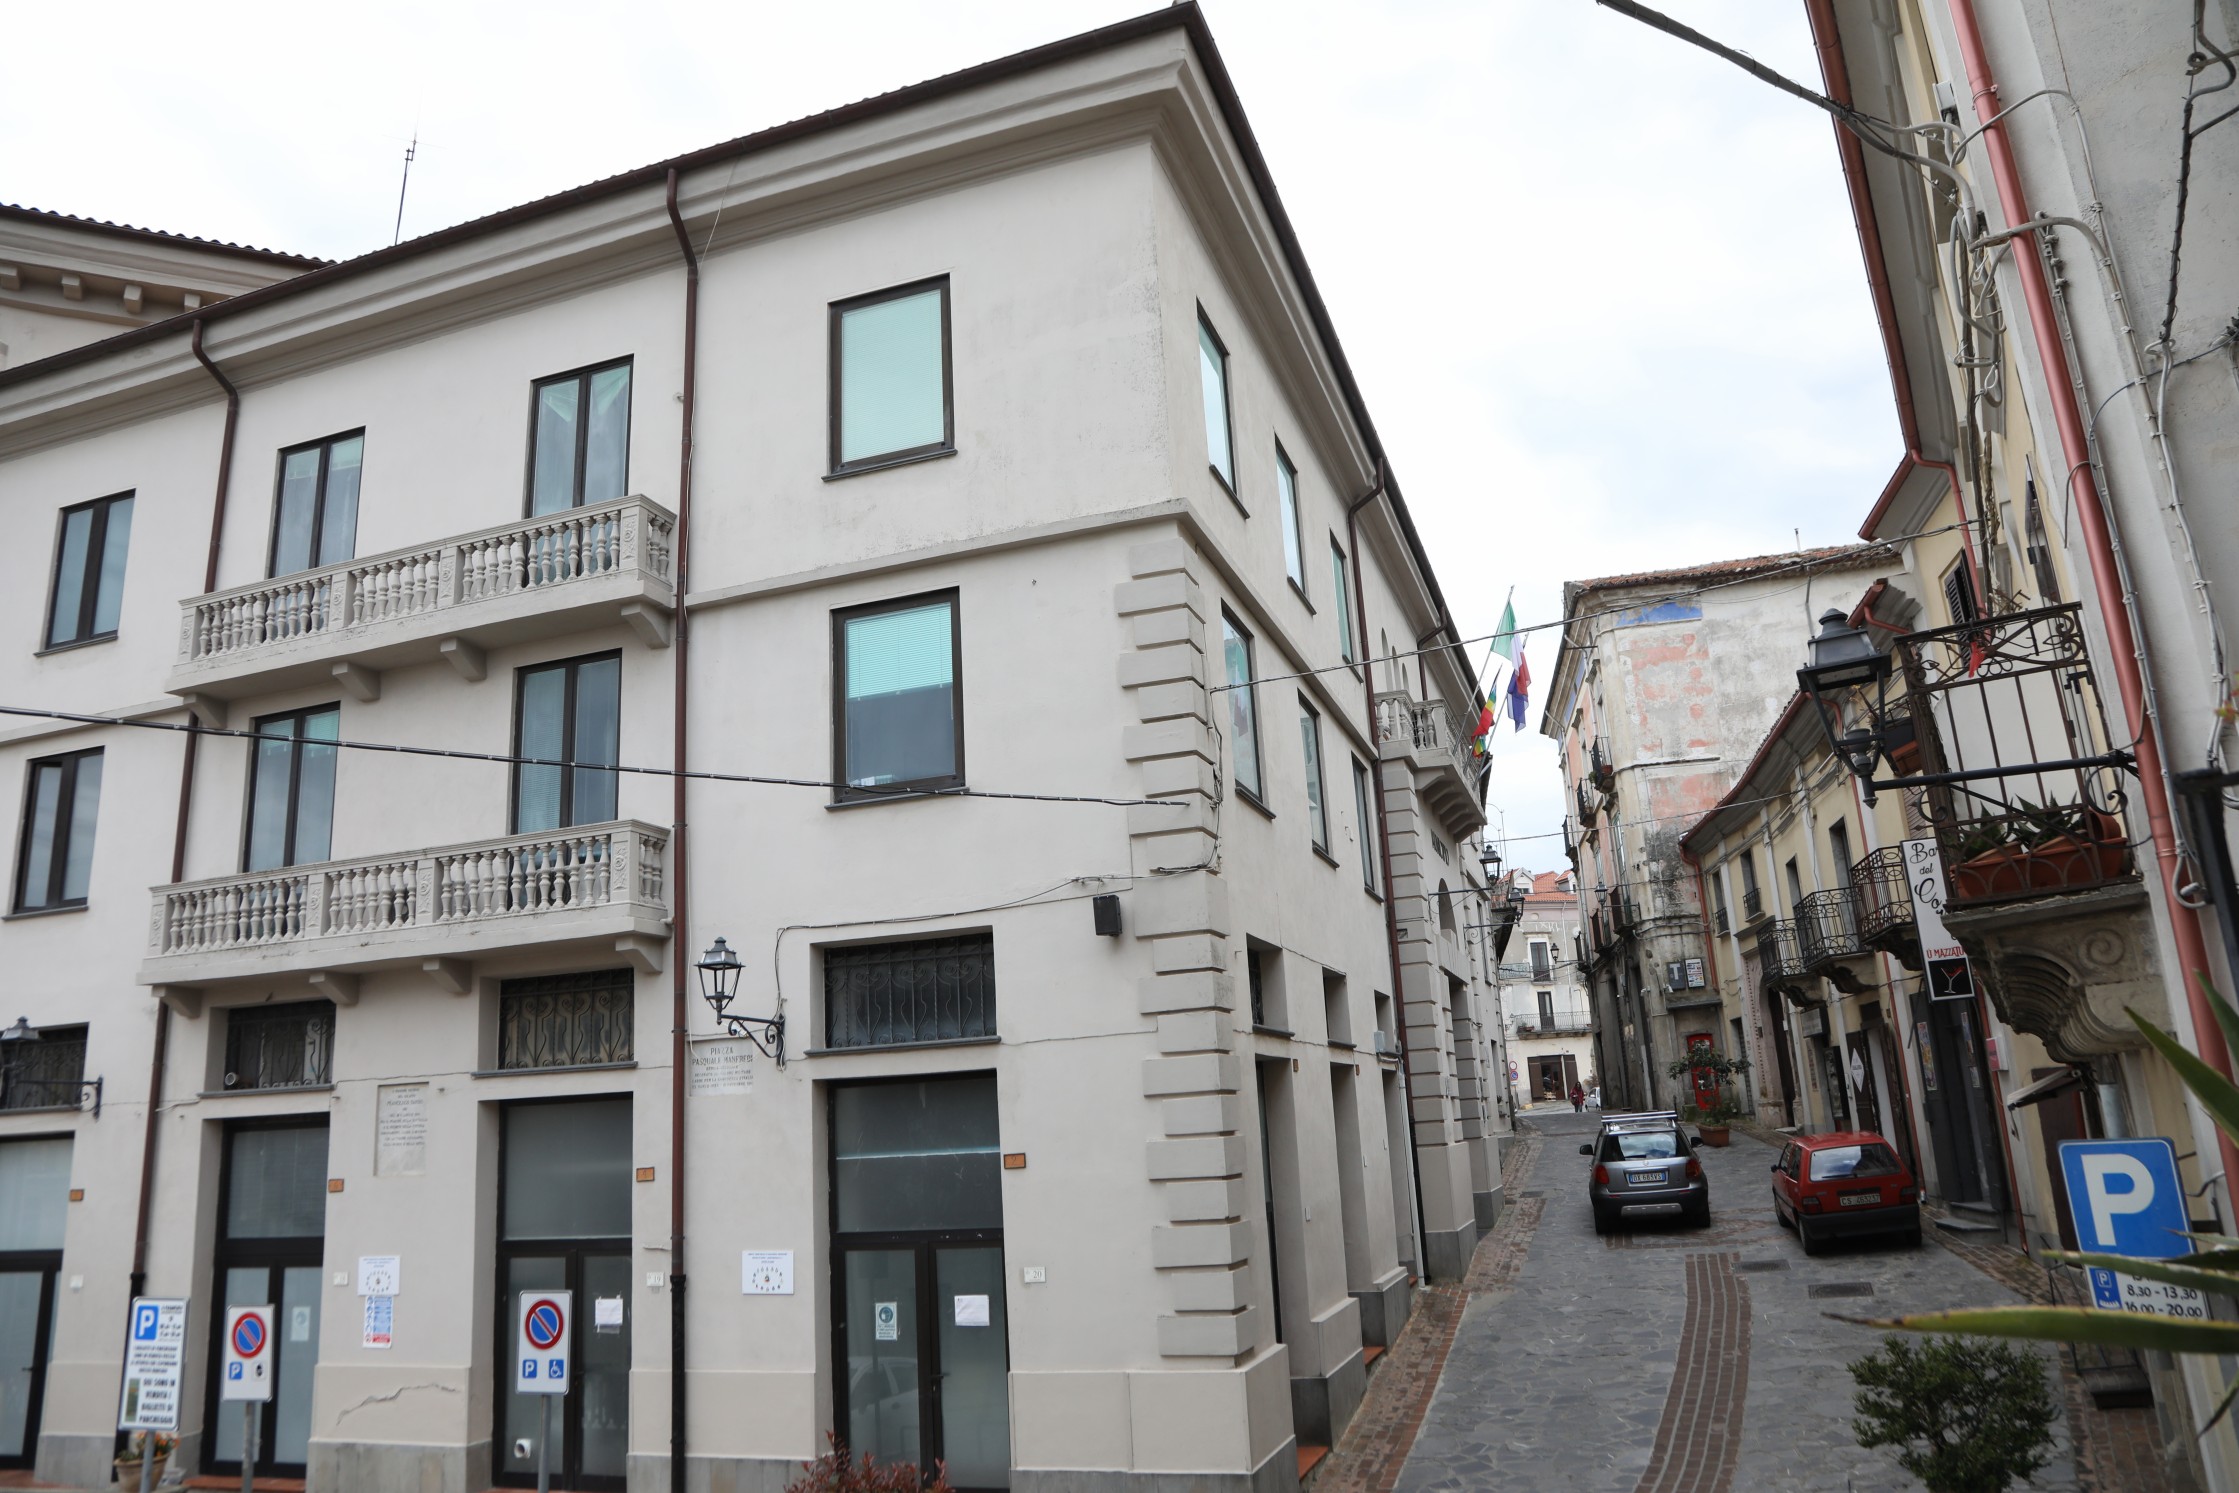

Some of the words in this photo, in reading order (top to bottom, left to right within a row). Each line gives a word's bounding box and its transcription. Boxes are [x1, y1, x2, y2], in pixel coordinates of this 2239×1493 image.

[1919, 863, 1934, 875] del
[710, 1046, 734, 1056] PIAZZA
[1841, 1197, 1853, 1206] CS
[2080, 1153, 2155, 1247] P
[1032, 1270, 1042, 1279] 20
[2098, 1272, 2108, 1286] P
[138, 1309, 156, 1338] P
[231, 1363, 241, 1379] P
[525, 1361, 535, 1377] P
